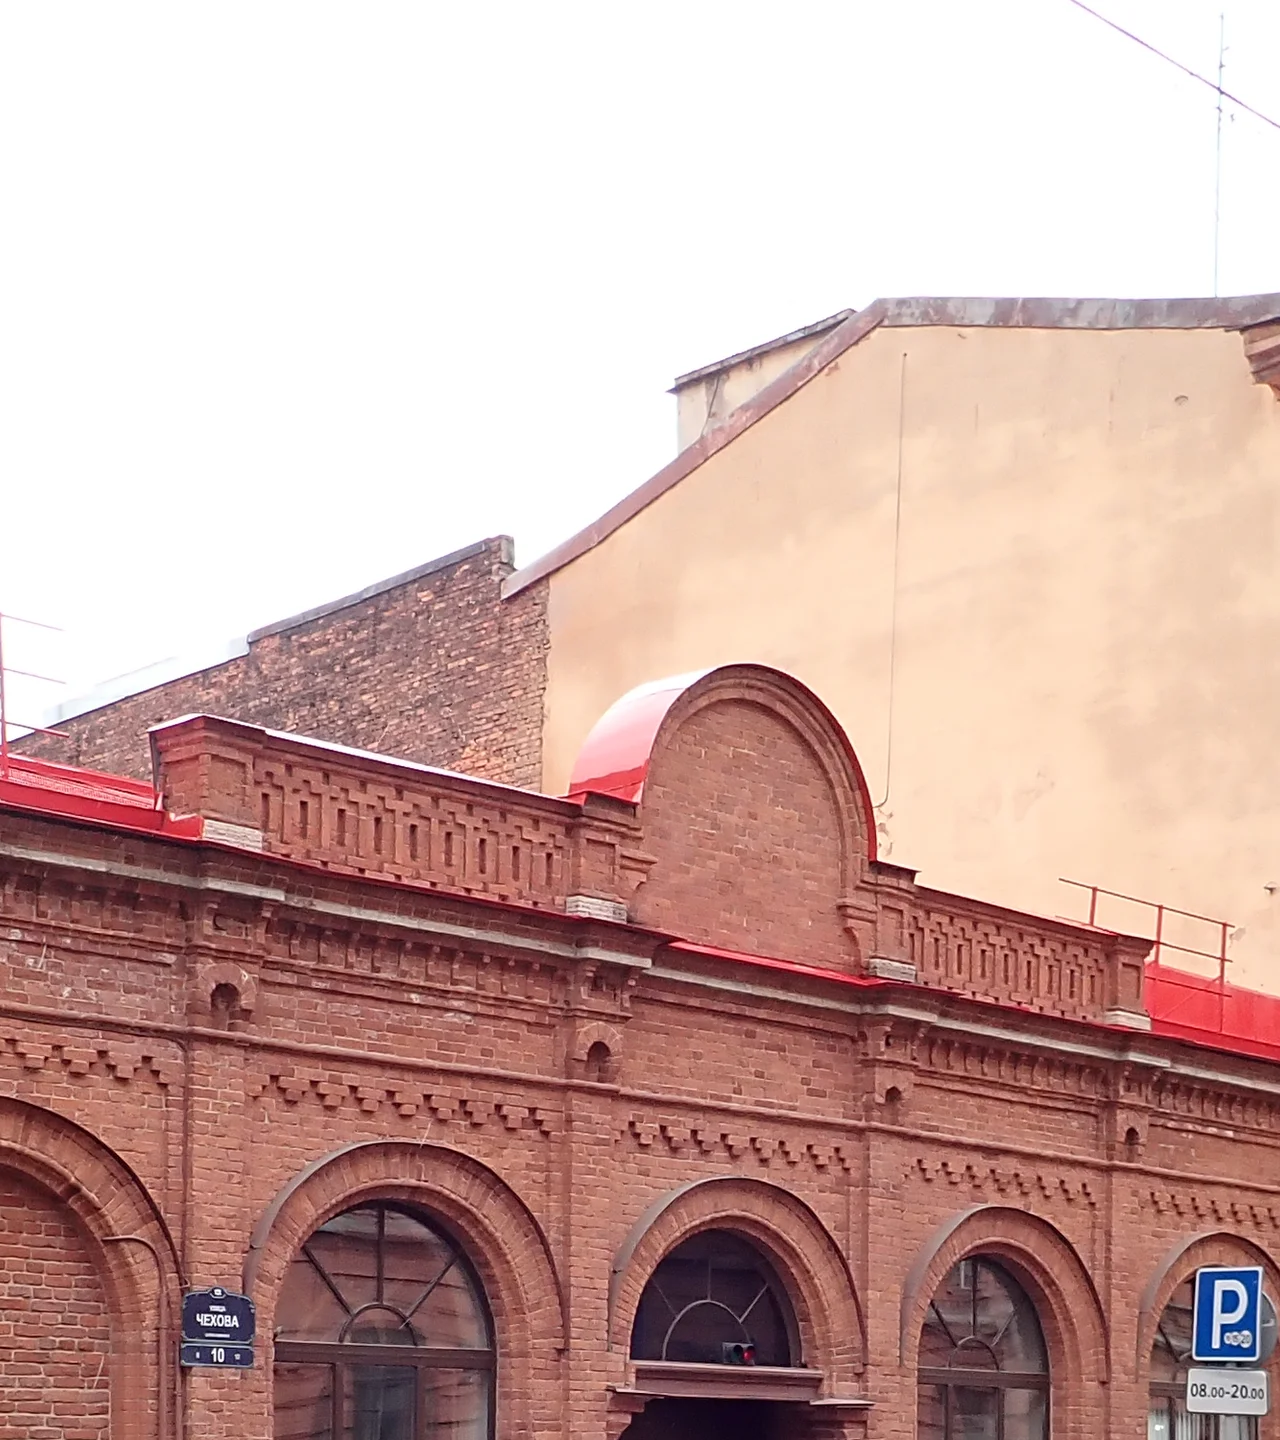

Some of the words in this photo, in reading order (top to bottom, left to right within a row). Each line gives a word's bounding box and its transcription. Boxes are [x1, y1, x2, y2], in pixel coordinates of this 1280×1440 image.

[195, 1313, 240, 1328] ЧЕХОВА
[1211, 1279, 1249, 1349] P
[210, 1347, 226, 1363] 10
[1190, 1383, 1265, 1400] 08.00-20.00
